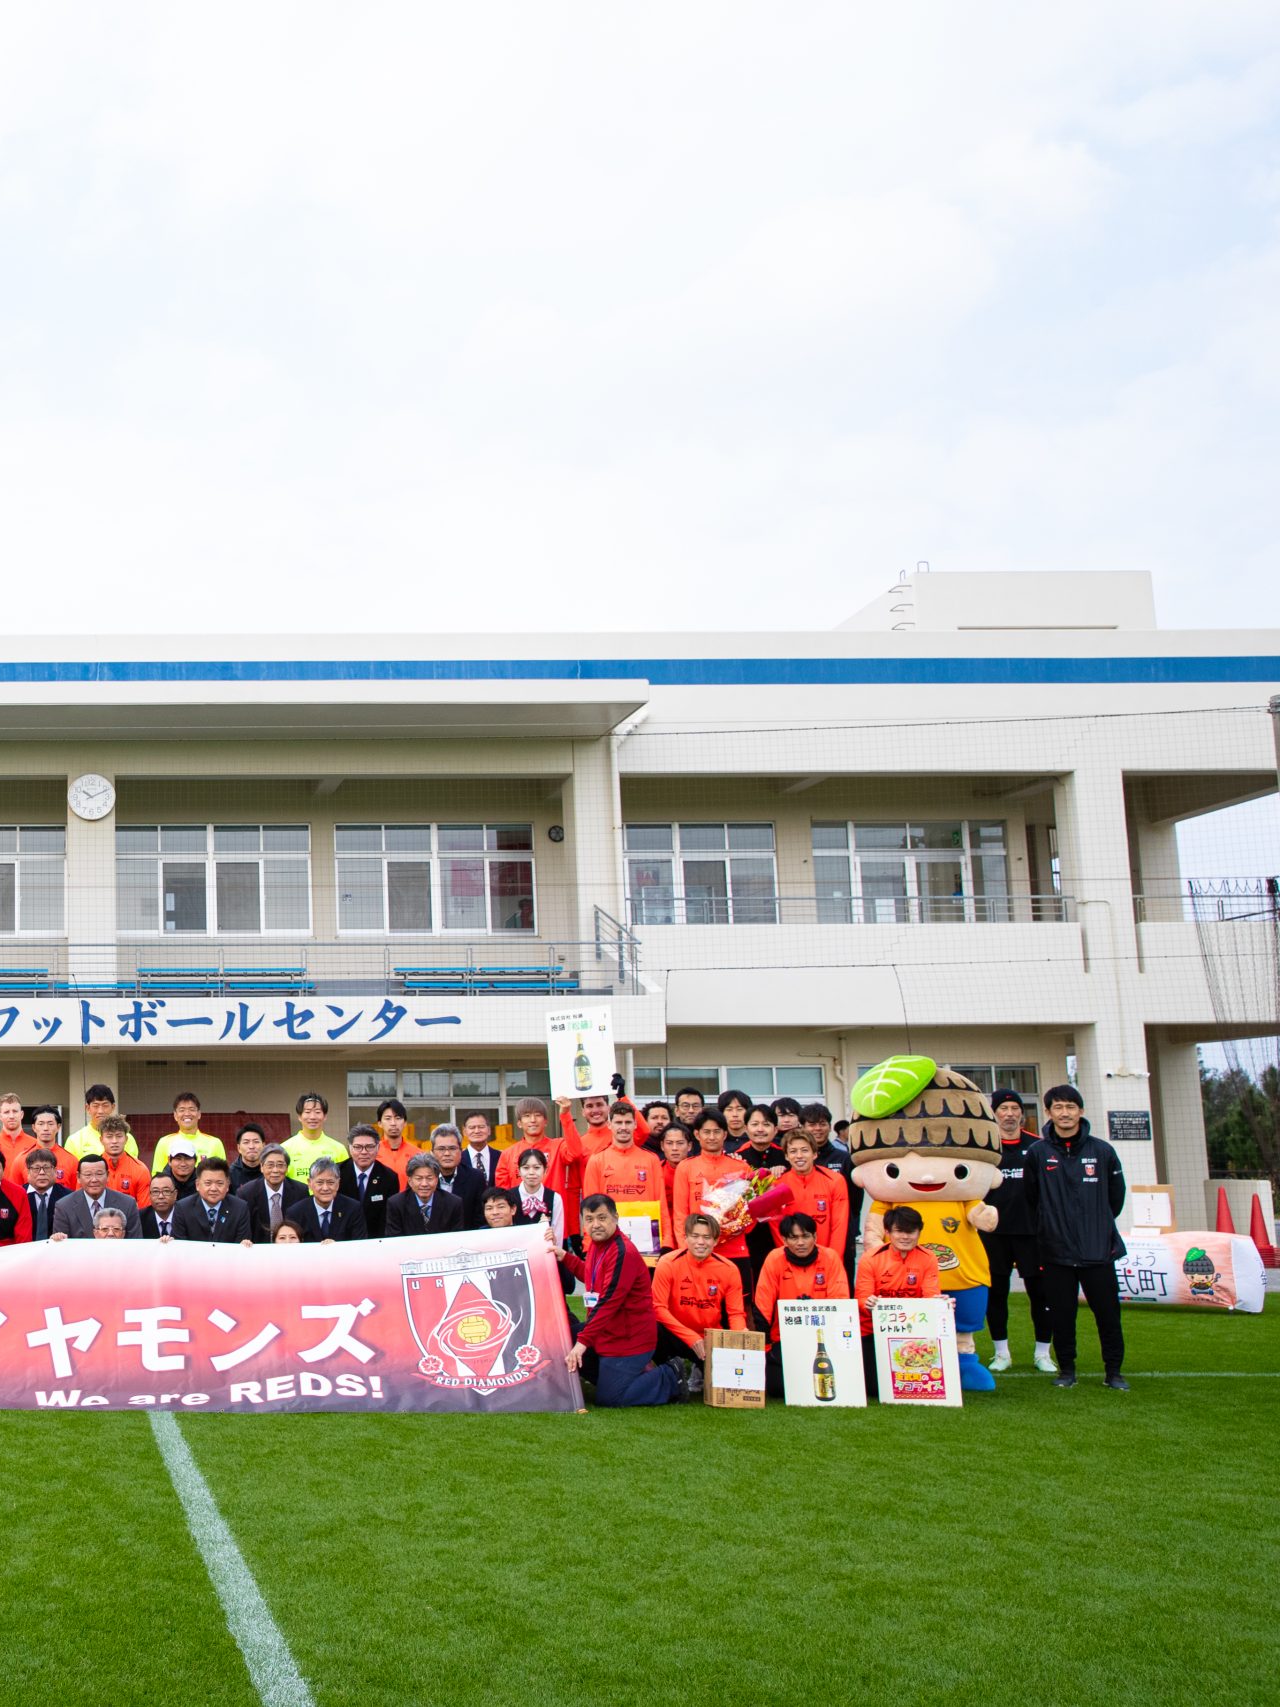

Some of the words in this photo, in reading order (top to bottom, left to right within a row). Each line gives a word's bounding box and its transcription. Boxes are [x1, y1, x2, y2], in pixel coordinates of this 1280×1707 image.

[411, 1267, 522, 1290] URAWA
[879, 1312, 928, 1323] タコライス
[880, 1325, 907, 1333] レトルト
[436, 1376, 460, 1387] RED
[464, 1369, 530, 1387] DIAMONDS
[128, 1393, 210, 1406] are
[229, 1372, 384, 1404] REDS!
[894, 1380, 944, 1392] タコライス
